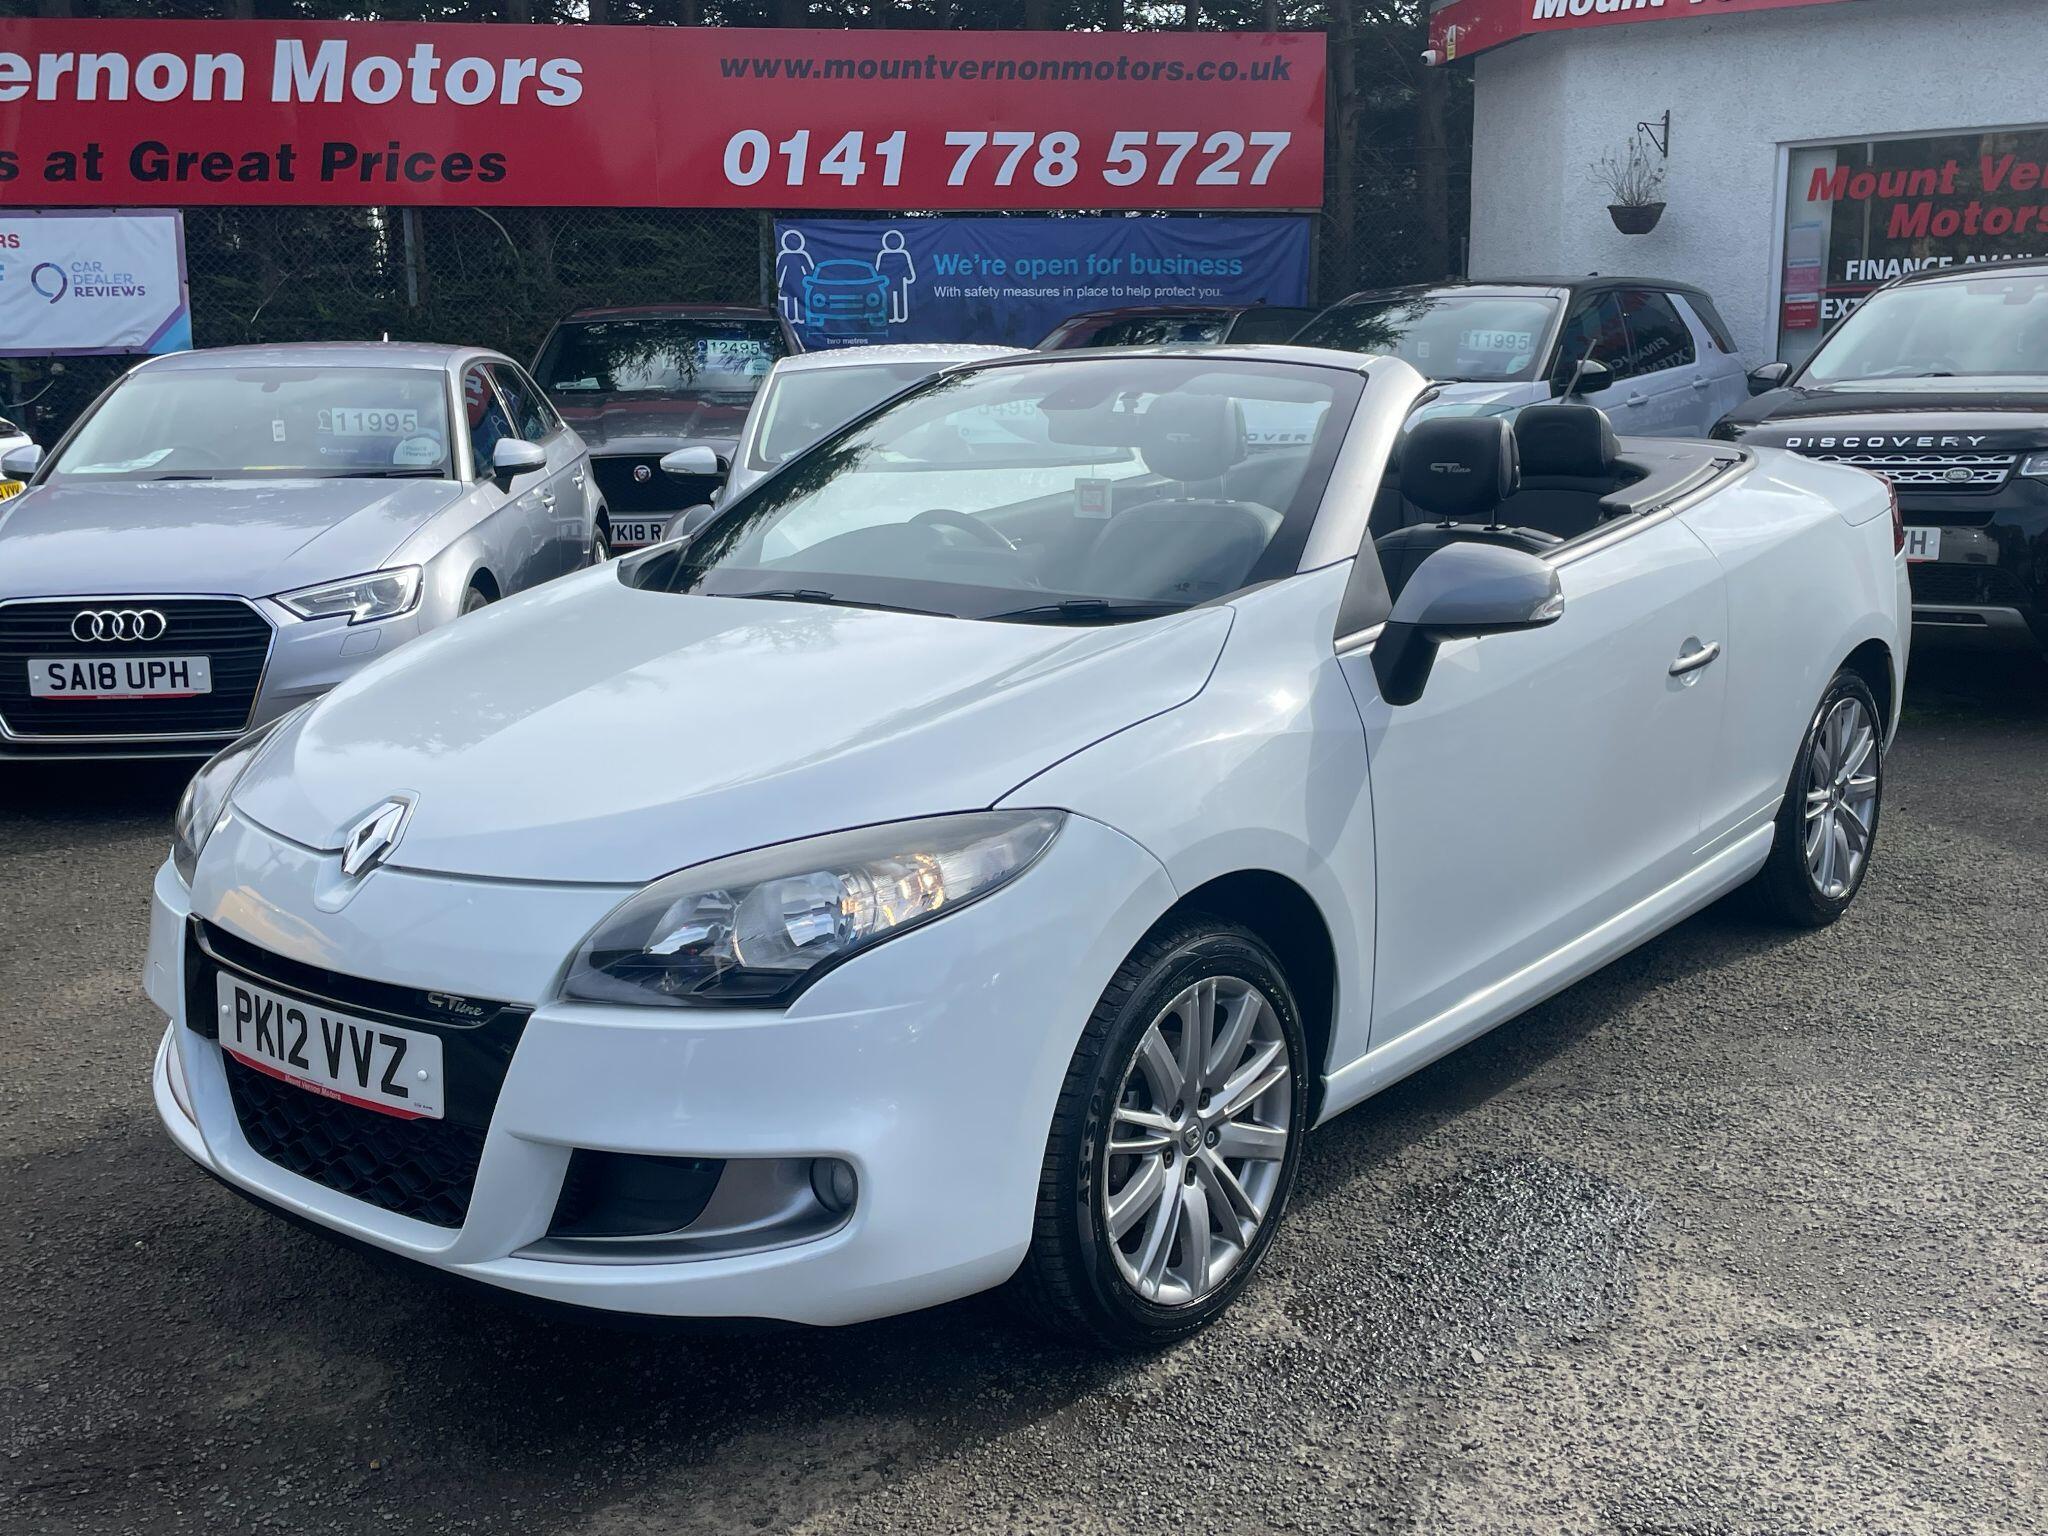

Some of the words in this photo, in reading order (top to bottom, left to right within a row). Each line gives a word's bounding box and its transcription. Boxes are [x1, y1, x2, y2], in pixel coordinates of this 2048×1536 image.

[271, 39, 583, 107] Motors
[720, 54, 1292, 81] www.mountvernonmotors.co.uk
[43, 143, 104, 182] at
[129, 140, 297, 182] Great
[320, 140, 507, 182] Prices
[723, 129, 907, 186] 0141
[944, 131, 1081, 187] 778
[1102, 131, 1292, 187] 5727
[1807, 159, 1960, 202] Mount
[1980, 153, 2048, 192] Ve
[71, 261, 104, 273] CAR
[72, 273, 134, 285] DEALER
[1014, 257, 1079, 280] open
[1086, 253, 1122, 275] for
[1130, 252, 1243, 275] business
[74, 285, 146, 298] REVIEWS
[933, 285, 961, 298] With
[964, 285, 1000, 300] safety
[1003, 287, 1060, 298] measures
[1063, 285, 1073, 298] in
[1076, 285, 1109, 300] place
[1111, 286, 1123, 297] to
[1126, 284, 1151, 299] help
[1154, 285, 1196, 299] protect
[1785, 436, 1986, 448] DISCOVERY
[1904, 530, 1928, 555] H
[48, 662, 117, 691] SA18
[125, 660, 190, 690] UPH
[234, 986, 309, 1070] PK12
[320, 1016, 409, 1099] VVZ
